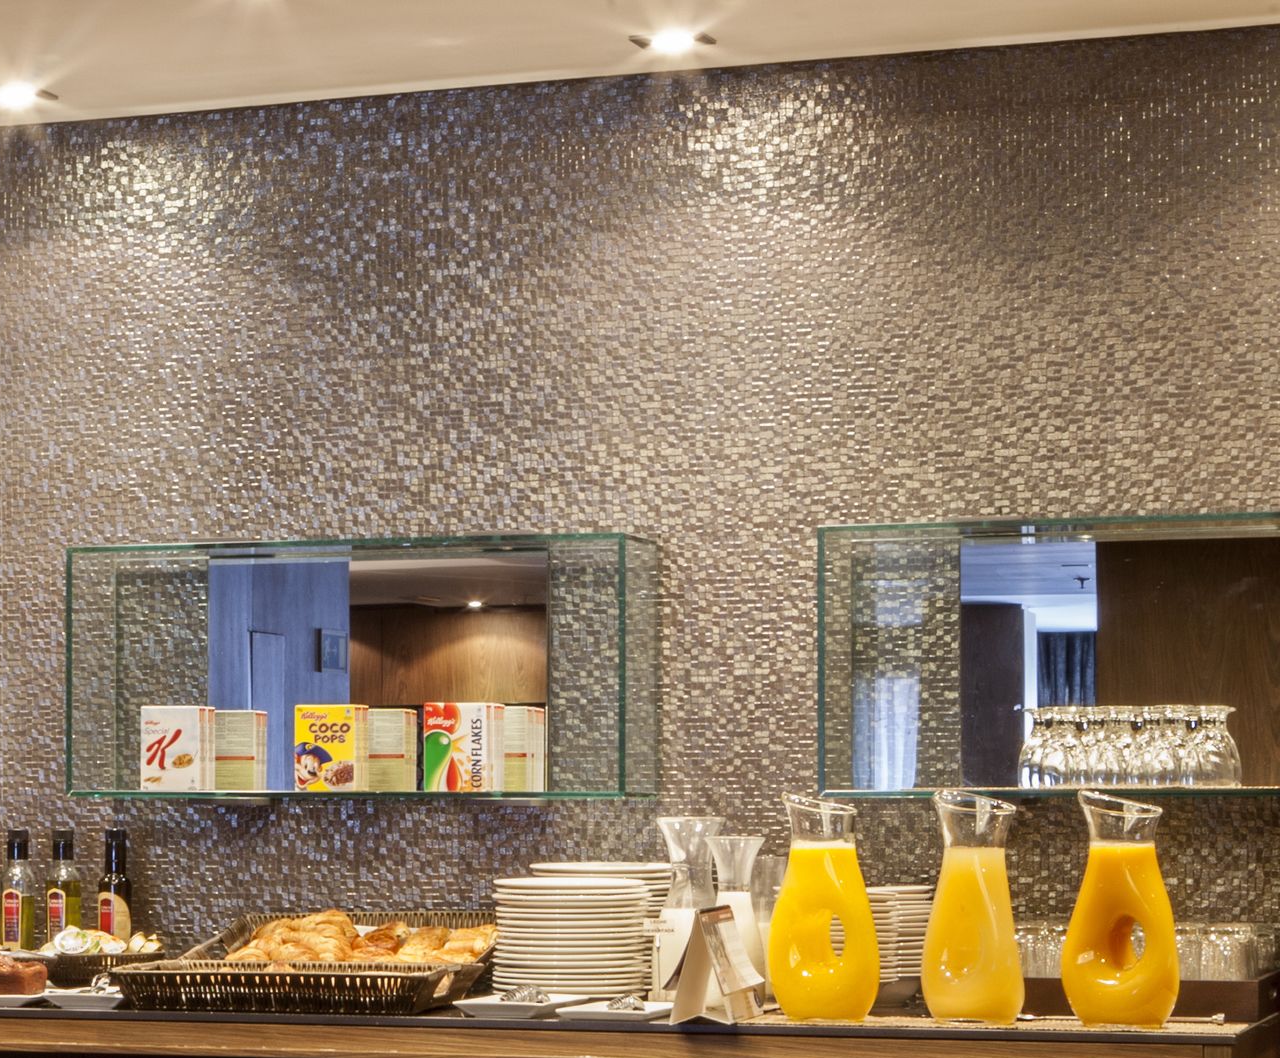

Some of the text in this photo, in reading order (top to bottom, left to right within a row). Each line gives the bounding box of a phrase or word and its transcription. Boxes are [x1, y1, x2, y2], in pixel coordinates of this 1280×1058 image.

[427, 716, 455, 727] Kellogg's
[308, 723, 351, 734] COCO
[314, 735, 346, 744] POPS
[144, 728, 182, 770] Special K
[471, 718, 482, 788] CORN FLAKES
